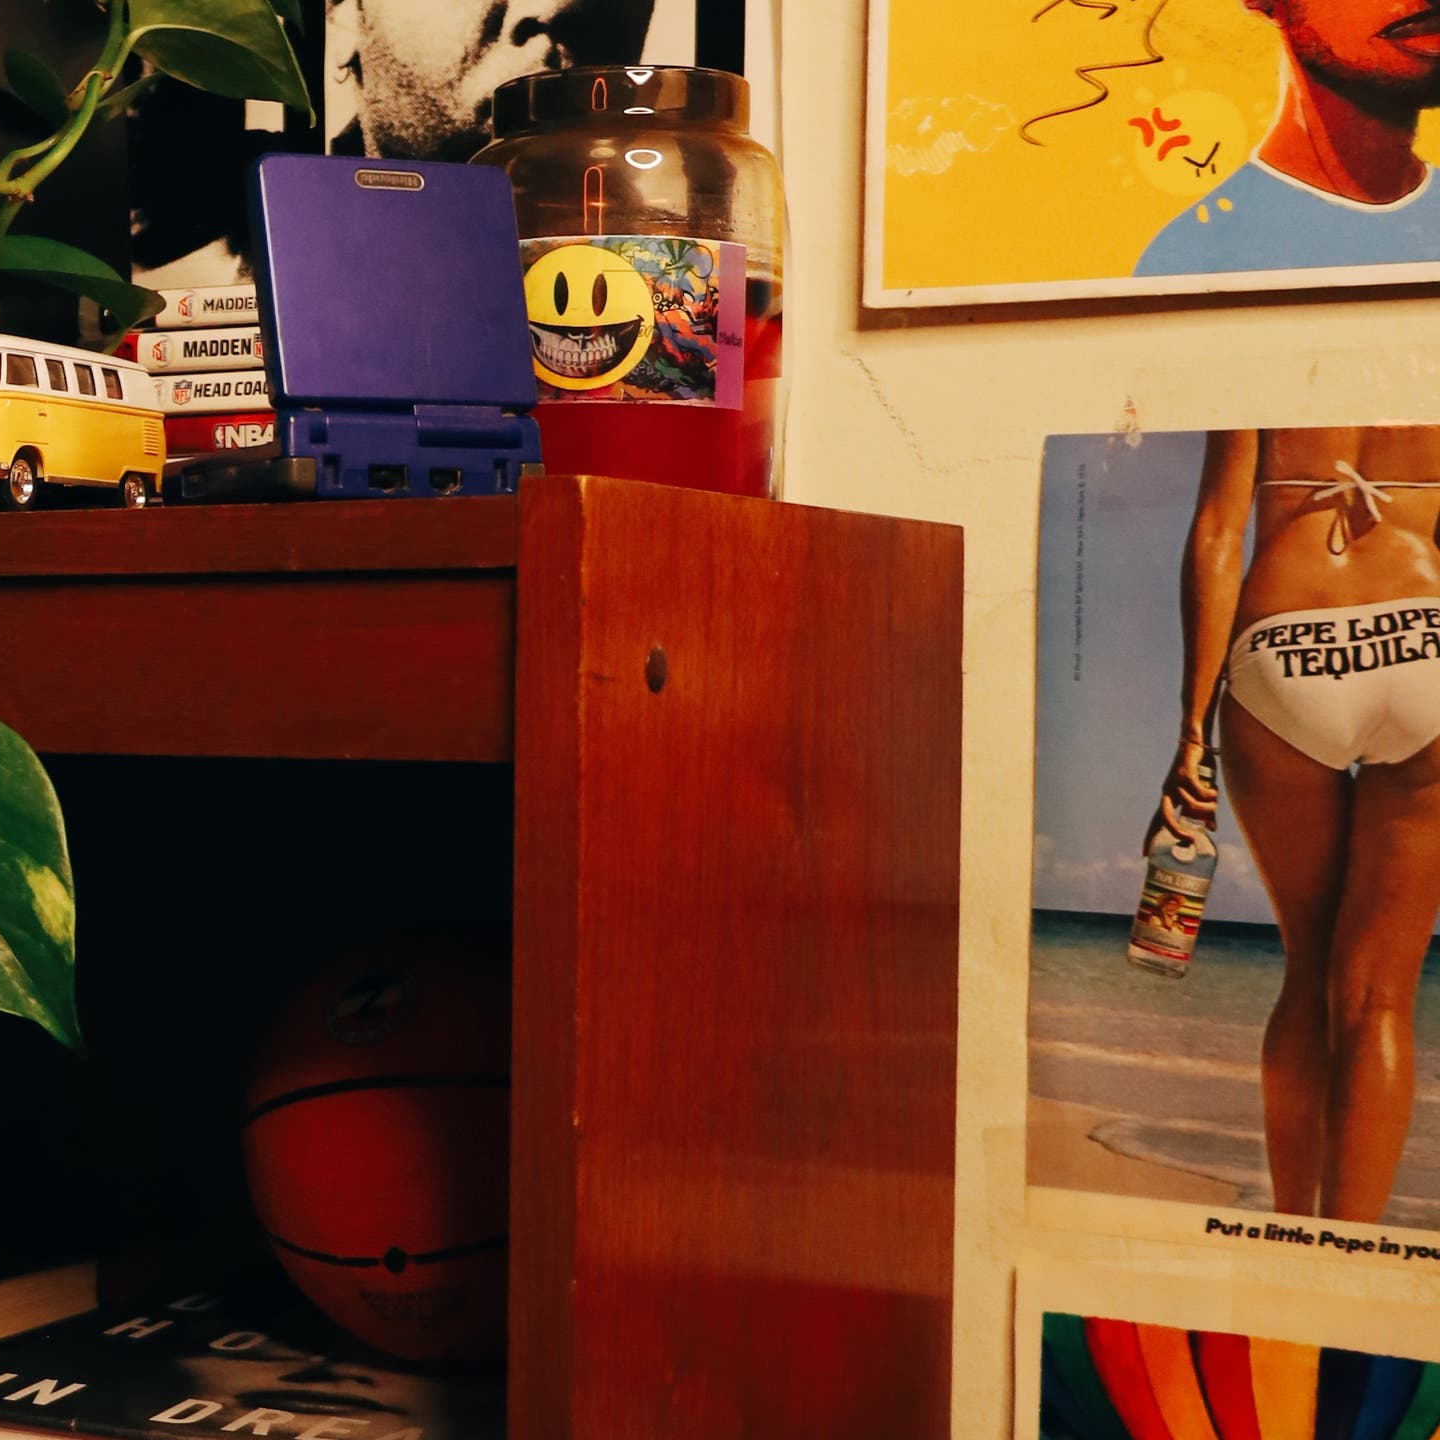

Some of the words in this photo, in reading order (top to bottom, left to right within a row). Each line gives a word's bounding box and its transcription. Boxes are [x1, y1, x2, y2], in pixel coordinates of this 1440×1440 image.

[183, 338, 252, 358] MADDEN
[194, 382, 232, 398] HEAD
[225, 424, 274, 449] NBA
[1248, 621, 1337, 653] PEPE
[1275, 632, 1440, 681] TEQUILA
[1205, 1216, 1243, 1239] Put
[1247, 1225, 1261, 1241] a
[1263, 1222, 1315, 1249] little
[1318, 1231, 1377, 1258] Pepe
[1380, 1237, 1399, 1254] in
